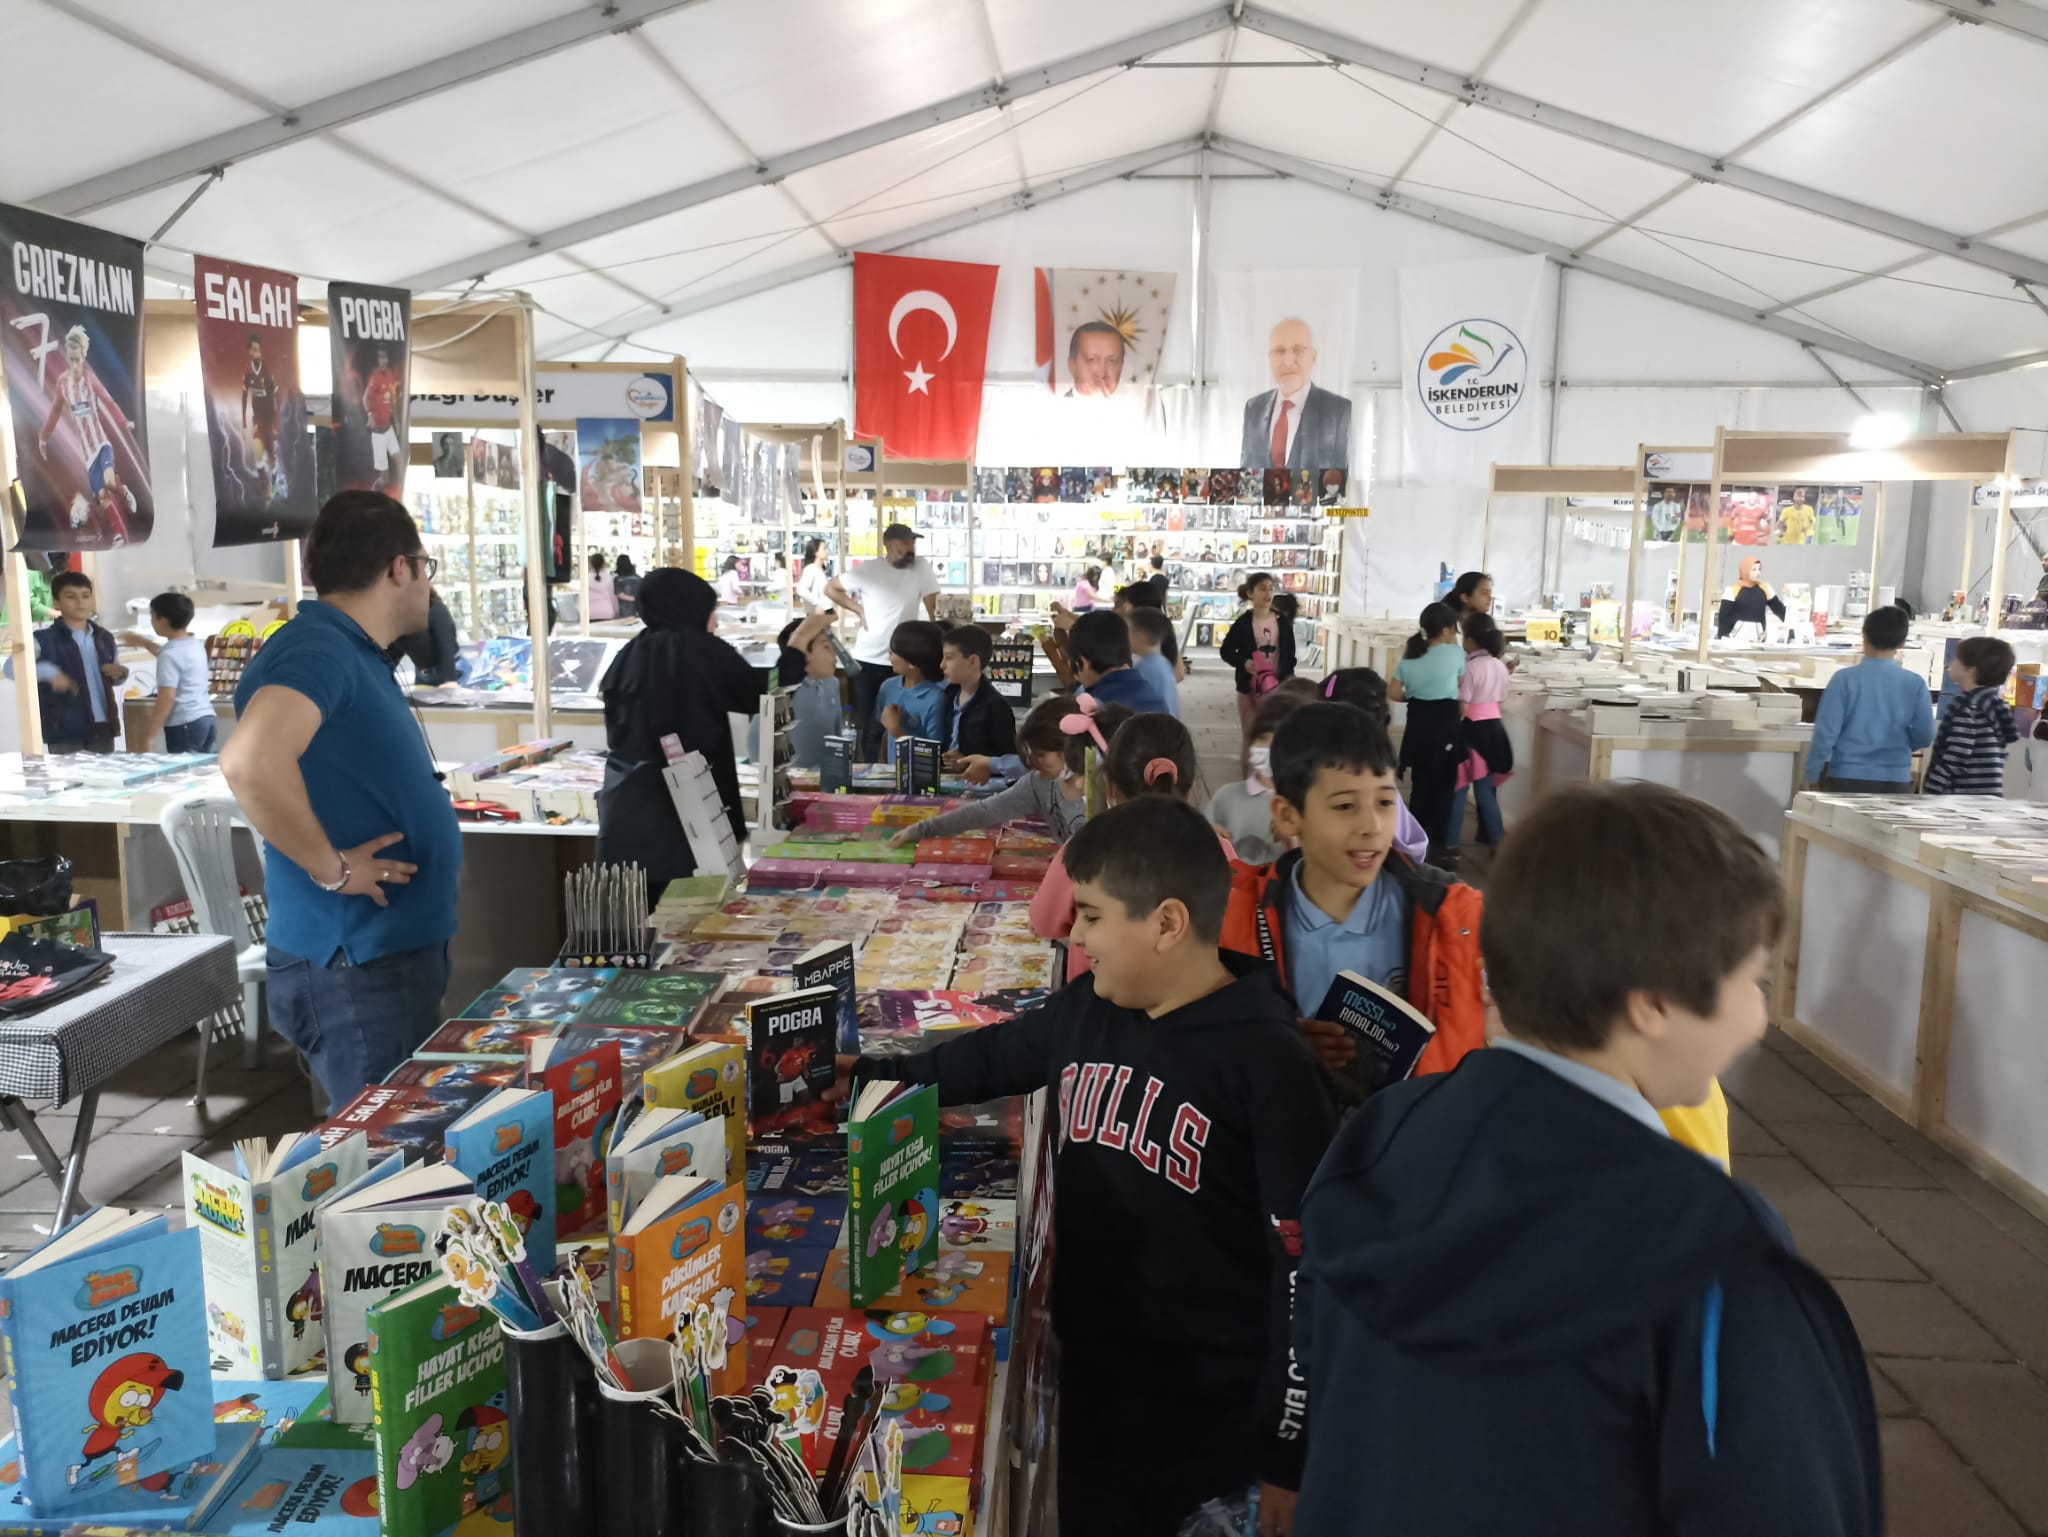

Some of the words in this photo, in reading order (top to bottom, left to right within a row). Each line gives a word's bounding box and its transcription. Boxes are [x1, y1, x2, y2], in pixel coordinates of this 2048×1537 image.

[13, 241, 135, 316] GRIEZMANN
[204, 272, 293, 329] SALAH
[339, 296, 405, 342] POGBA
[9, 312, 59, 392] 7
[1428, 382, 1518, 402] İSKENDERUN
[1435, 399, 1510, 415] BELEDİYESİ
[1544, 630, 1558, 640] 10
[804, 955, 852, 988] MBAPPÉ
[768, 1006, 823, 1037] POGBA
[1342, 990, 1385, 1021] MESSI
[1339, 1007, 1386, 1041] RONALDO
[346, 1088, 398, 1123] SALAH
[571, 1102, 600, 1130] OLUR!
[320, 1126, 350, 1151] LAH
[487, 1159, 531, 1200] EDİYOR!
[343, 1260, 432, 1293] MACERA
[661, 1244, 721, 1296] DÜRÜMLER
[50, 1310, 116, 1350] MACERA
[121, 1288, 175, 1322] DEVAM
[71, 1314, 158, 1368] EDİYOR!
[418, 1341, 465, 1383] HAYAT
[467, 1321, 501, 1356] KISA
[838, 1329, 863, 1358] OLUR!
[405, 1370, 454, 1413] FİLLER
[457, 1341, 505, 1384] UÇUYO
[267, 1495, 301, 1533] MACERA
[296, 1474, 345, 1523] EDİYOR!
